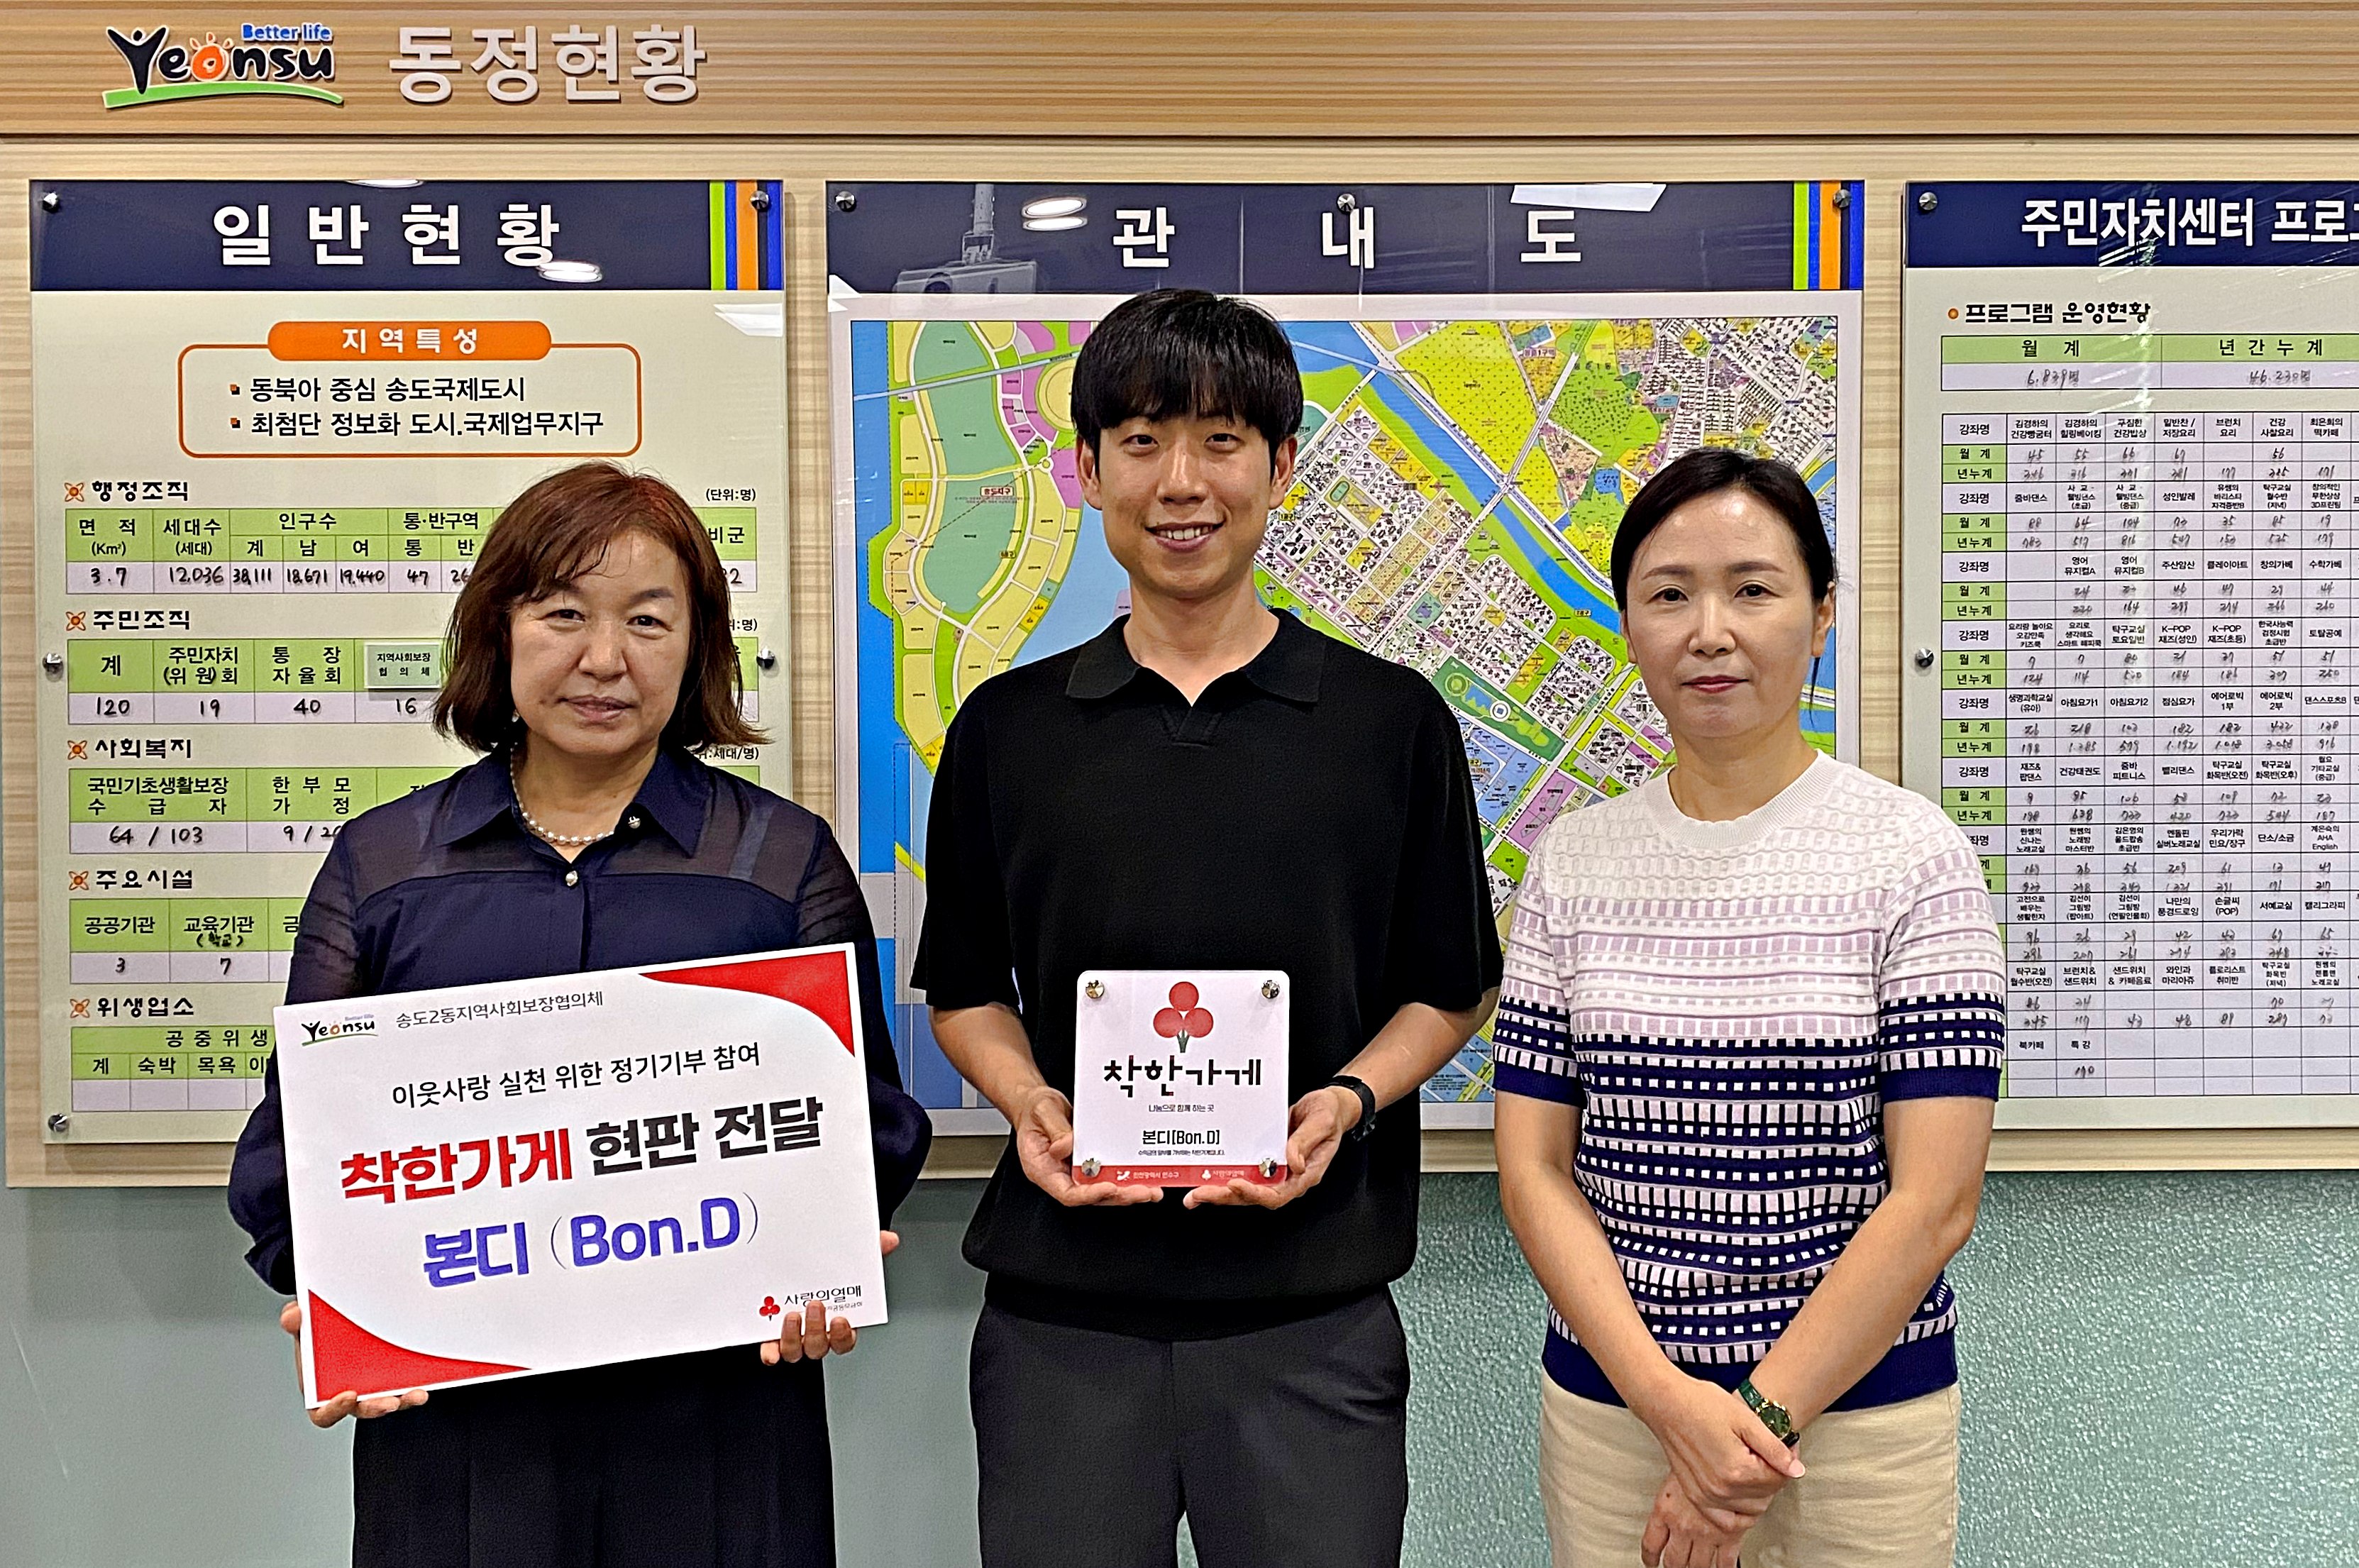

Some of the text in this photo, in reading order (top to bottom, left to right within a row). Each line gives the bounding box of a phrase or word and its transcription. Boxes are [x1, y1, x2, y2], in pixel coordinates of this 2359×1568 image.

[241, 23, 333, 42] Better life
[105, 26, 335, 94] Yeonsu
[389, 23, 709, 104] 동정현황
[2020, 196, 2256, 248] 주민자치센터
[1965, 302, 2151, 324] 프로그램 운영현황
[250, 377, 524, 402] 동북아 중심 송도국제도시
[251, 411, 604, 437] 최첨단 정보화 도시.국제업무지구
[1959, 424, 1990, 436] 강좌명
[2015, 419, 2048, 429] 김경하의
[2065, 419, 2098, 429] 김경하의
[2215, 418, 2241, 427] 브런치
[2270, 418, 2286, 427] 건강
[2162, 429, 2196, 438] 저장요리
[2219, 429, 2236, 438] 요리
[92, 480, 188, 502] 행정조직
[705, 488, 756, 502] (단위:명)
[2263, 483, 2292, 492] 탁구교실
[1959, 492, 1989, 504] 강좌명
[2162, 492, 2196, 502] 성인발레
[162, 518, 222, 536] 세대수
[279, 512, 337, 531] 인구수
[175, 541, 213, 556] (세대)
[247, 539, 263, 558] 계
[299, 539, 317, 557] 남
[353, 539, 369, 557] 여
[404, 539, 422, 557] 통
[458, 539, 475, 556] 반
[1959, 561, 1989, 573] 강좌명
[2072, 556, 2089, 565] 영어
[2121, 556, 2138, 565] 영어
[2260, 560, 2293, 570] 창의가베
[407, 568, 429, 586] 47
[93, 610, 190, 631] 주민조직
[1959, 629, 1989, 641] 강좌명
[2111, 624, 2145, 634] 탁구교실
[168, 646, 238, 665] 주민자치
[377, 652, 431, 663] 지역사회보장
[100, 654, 121, 677] 계
[2060, 698, 2098, 707] 아침요가1
[2110, 697, 2149, 707] 아침요가2
[2162, 697, 2195, 707] 점심요가
[2211, 691, 2244, 701] 에어로빅
[2260, 691, 2293, 700] 에어로빅
[96, 697, 131, 717] 120
[200, 699, 221, 717] 19
[293, 698, 321, 715] 40
[395, 697, 417, 714] 16
[1958, 697, 1989, 710] 강좌명
[2221, 702, 2234, 711] 1부
[2270, 702, 2284, 711] 2부
[95, 738, 192, 759] 사회복지
[1959, 766, 1989, 778] 강좌명
[2212, 761, 2243, 770] 탁구교실
[2261, 760, 2292, 769] 탁구교실
[87, 776, 229, 795] 국민기초생활보장
[171, 826, 203, 844] 103
[2211, 829, 2244, 838] 우리가락
[2258, 833, 2294, 843] 단소/소금
[2016, 845, 2045, 854] 노래교실
[2209, 839, 2245, 849] 민요/장구
[96, 870, 192, 890] 주요시설
[2214, 896, 2240, 905] 손글씨
[2259, 901, 2293, 910] 서예교실
[2215, 907, 2239, 917] (POP)
[84, 916, 156, 935] 공공기관
[183, 915, 255, 934] 교육기관
[115, 957, 126, 973] 3
[220, 957, 232, 976] 7
[2112, 966, 2146, 975] 샌드위치
[2166, 966, 2192, 975] 와인과
[2063, 977, 2097, 986] 샌드위치
[97, 997, 194, 1018] 위생업소
[395, 990, 604, 1029] 송도2동지역사회보장협의체
[302, 1020, 375, 1042] Yeonsu
[92, 1057, 109, 1075] 계
[138, 1056, 177, 1075] 숙박
[197, 1056, 236, 1074] 목욕
[392, 1042, 760, 1108] 이웃사랑 실천 위한 정기기부 참여
[1103, 1054, 1261, 1098] 착한가게
[1207, 1104, 1215, 1112] 곳
[338, 1096, 824, 1206] 착한가게 현판 전달
[423, 1222, 529, 1288] 본디
